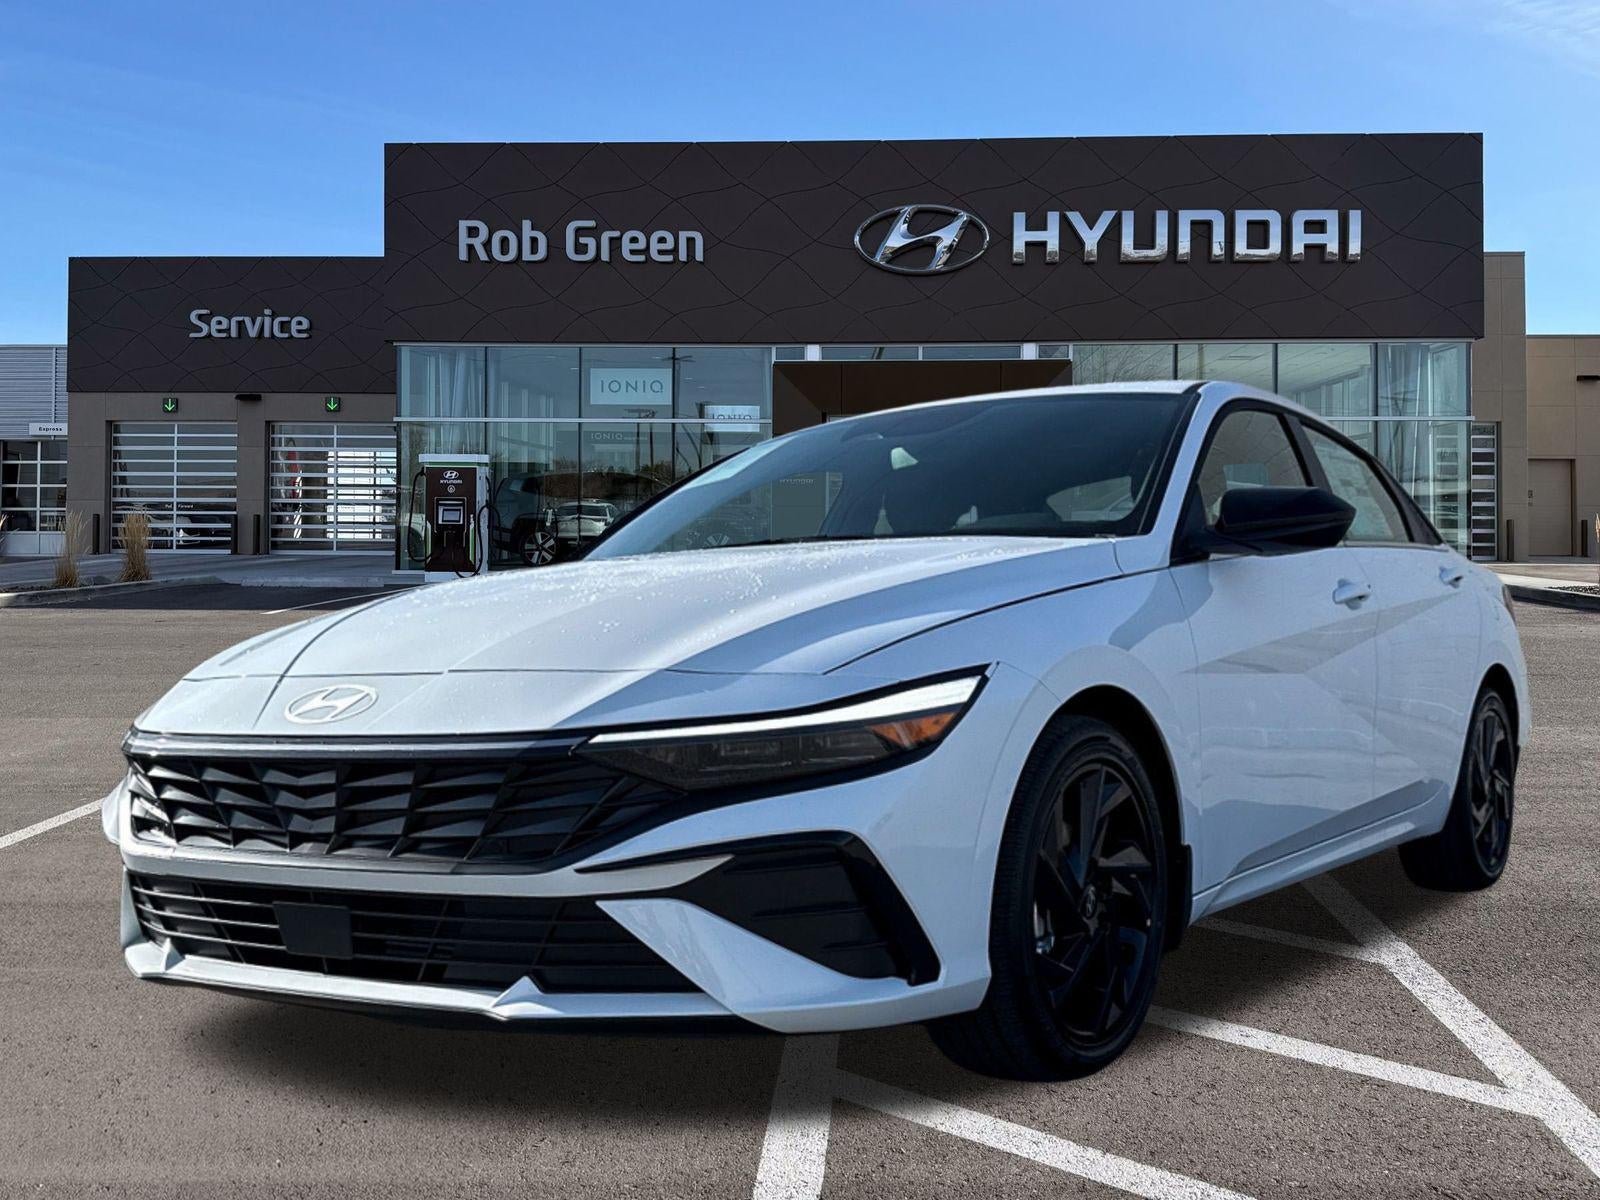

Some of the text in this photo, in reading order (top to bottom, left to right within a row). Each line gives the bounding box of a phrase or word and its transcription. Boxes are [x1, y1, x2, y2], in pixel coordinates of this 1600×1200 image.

[458, 219, 705, 263] Rob Green
[1011, 208, 1363, 264] HYUNDAI
[188, 308, 311, 339] Service
[600, 379, 664, 394] IONIQ
[591, 432, 623, 440] IONIQ
